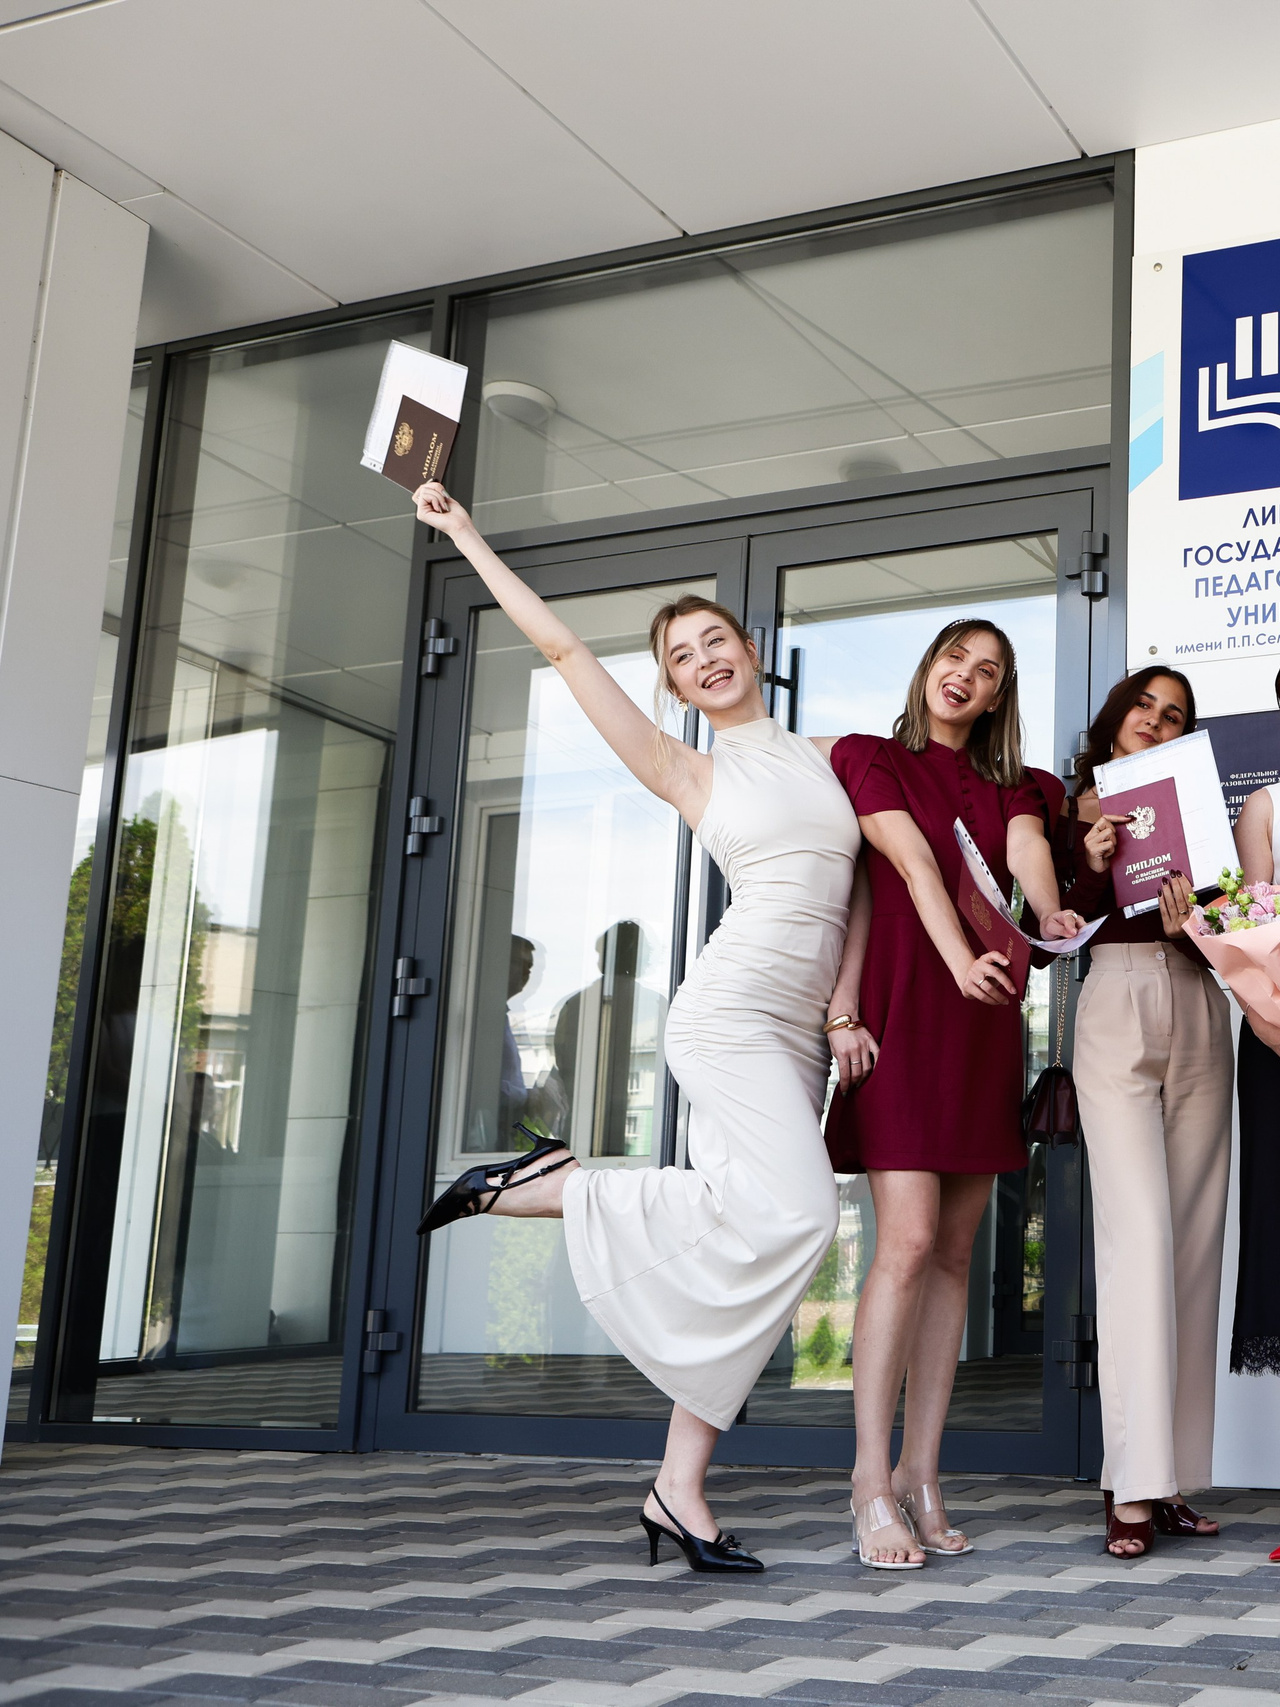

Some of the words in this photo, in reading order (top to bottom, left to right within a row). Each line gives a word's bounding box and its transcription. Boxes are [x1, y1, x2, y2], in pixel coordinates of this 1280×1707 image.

[422, 432, 438, 479] ДИПЛОМ
[1175, 639, 1223, 655] имени
[1230, 769, 1278, 779] ФЕДЕРАЛЬНОЕ
[1125, 853, 1171, 876] ДИПЛОМ
[1140, 867, 1164, 877] ВЫСШЕМ
[1131, 870, 1170, 885] ОБРАЗОВАНИИ
